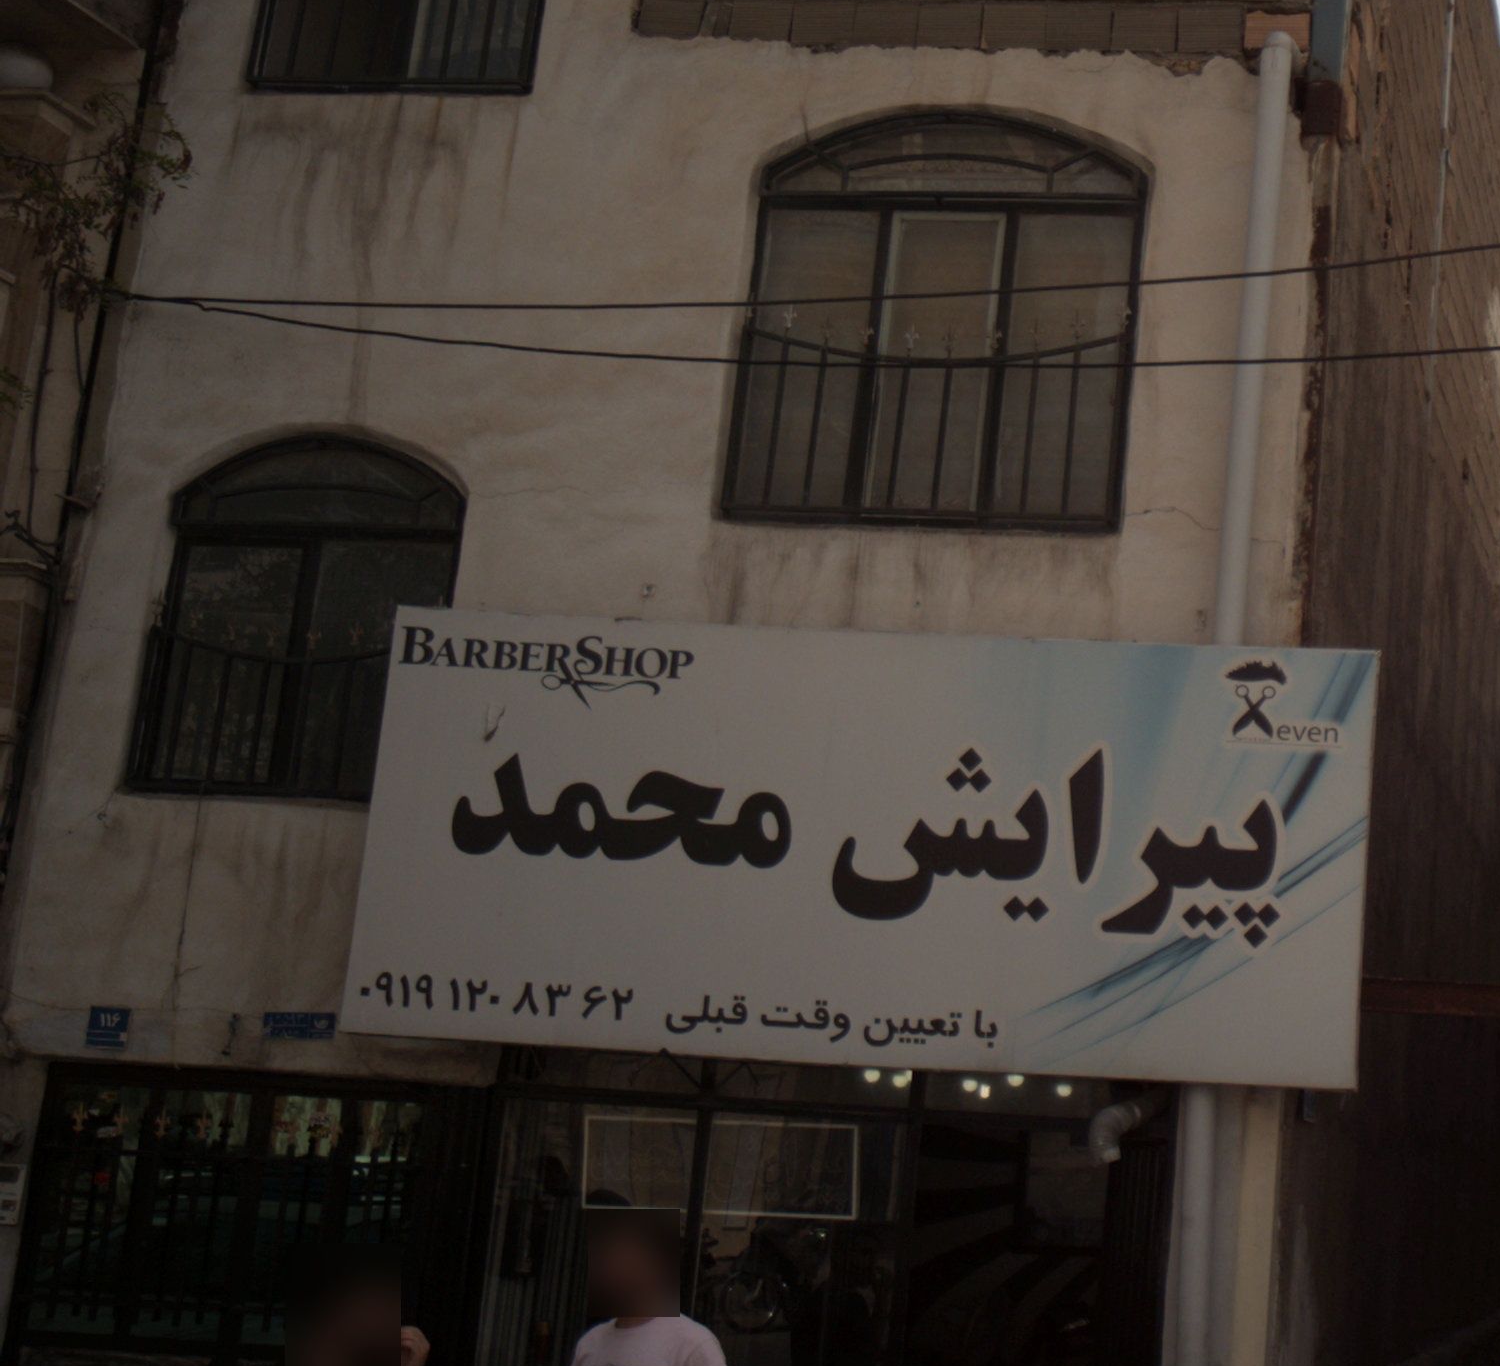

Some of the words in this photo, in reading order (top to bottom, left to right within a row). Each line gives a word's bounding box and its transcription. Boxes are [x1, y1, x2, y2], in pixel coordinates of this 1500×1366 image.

[451, 751, 792, 871] محمد
[831, 746, 1283, 949] پیرایش
[664, 994, 749, 1035] قبلی
[760, 999, 851, 1044] وقت
[862, 1011, 964, 1048] تعیین
[973, 1009, 999, 1049] با
